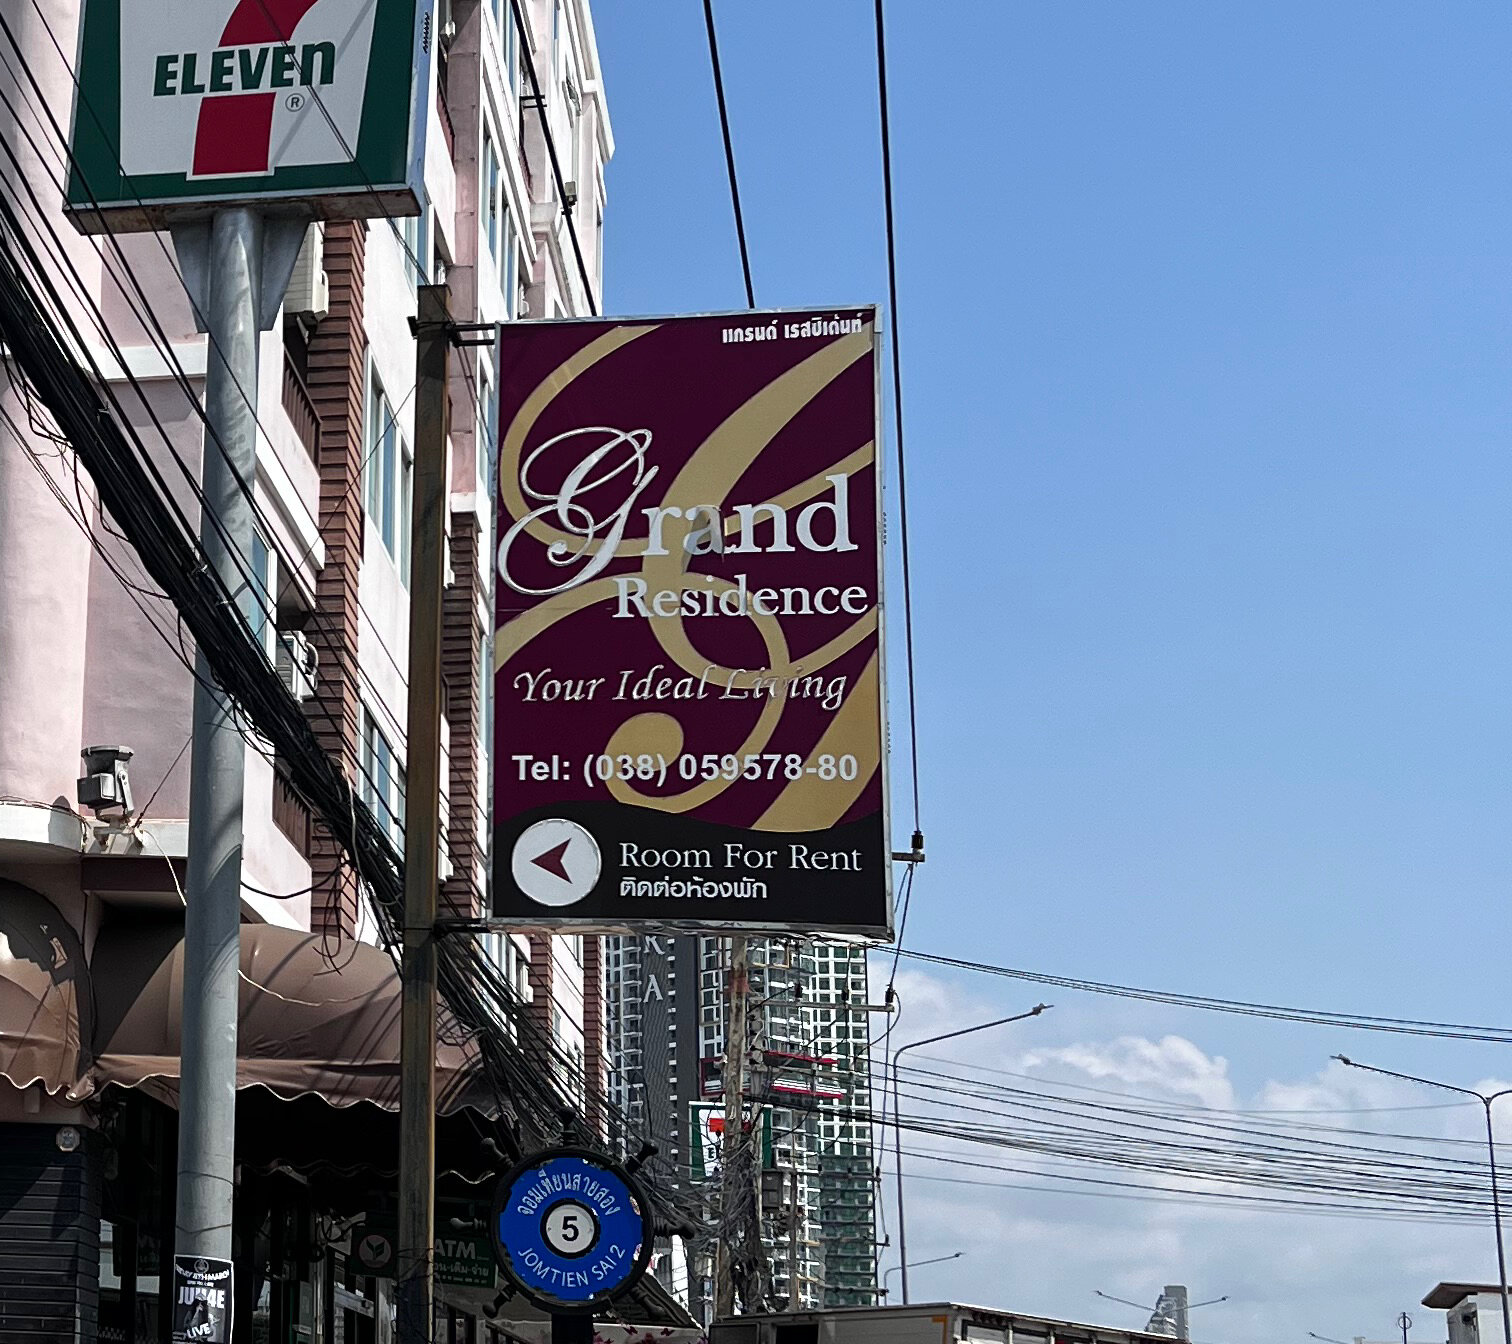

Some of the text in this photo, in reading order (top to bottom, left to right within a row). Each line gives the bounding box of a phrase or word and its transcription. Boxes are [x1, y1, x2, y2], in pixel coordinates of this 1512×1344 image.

[721, 320, 779, 345] แกรนด์
[498, 426, 858, 595] Grand
[612, 573, 869, 619] Residence
[512, 664, 849, 711] Your Ideal Living
[511, 753, 859, 787] Tel: (038) 059578-80
[619, 842, 863, 872] Room For Rent
[619, 876, 768, 900] ติดต่อห้องพัก
[517, 1168, 621, 1216] จอมเทียนสายสอง
[561, 1215, 580, 1242] 5
[434, 1238, 476, 1260] ATM
[517, 1244, 626, 1288] JOMTIEN SAI 2
[186, 1322, 211, 1339] LIVE
